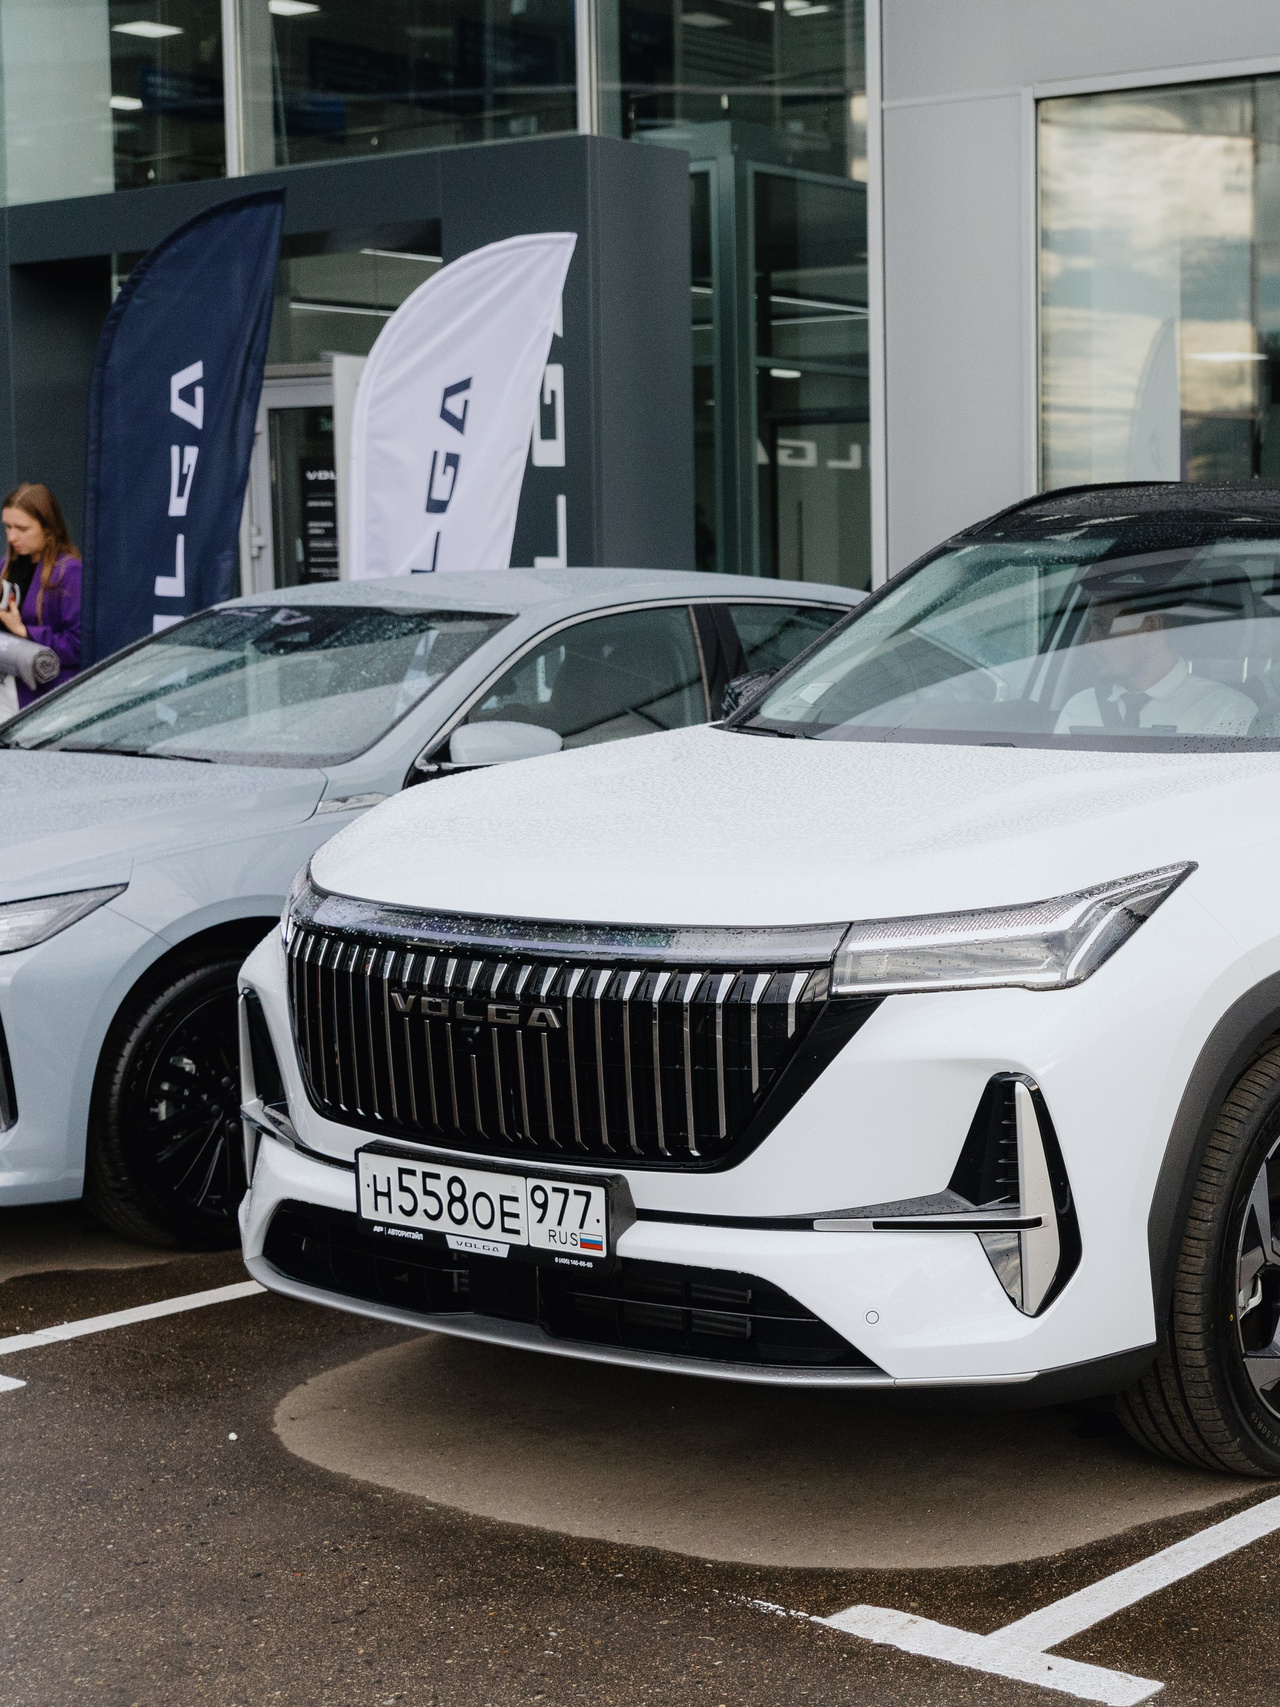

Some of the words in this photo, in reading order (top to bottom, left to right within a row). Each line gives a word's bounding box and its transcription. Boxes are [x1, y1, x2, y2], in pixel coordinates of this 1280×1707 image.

[532, 292, 568, 569] LG
[390, 991, 562, 1029] VOLGA
[529, 1184, 592, 1230] 977
[455, 1240, 500, 1253] VOLGA
[548, 1228, 578, 1247] RUS
